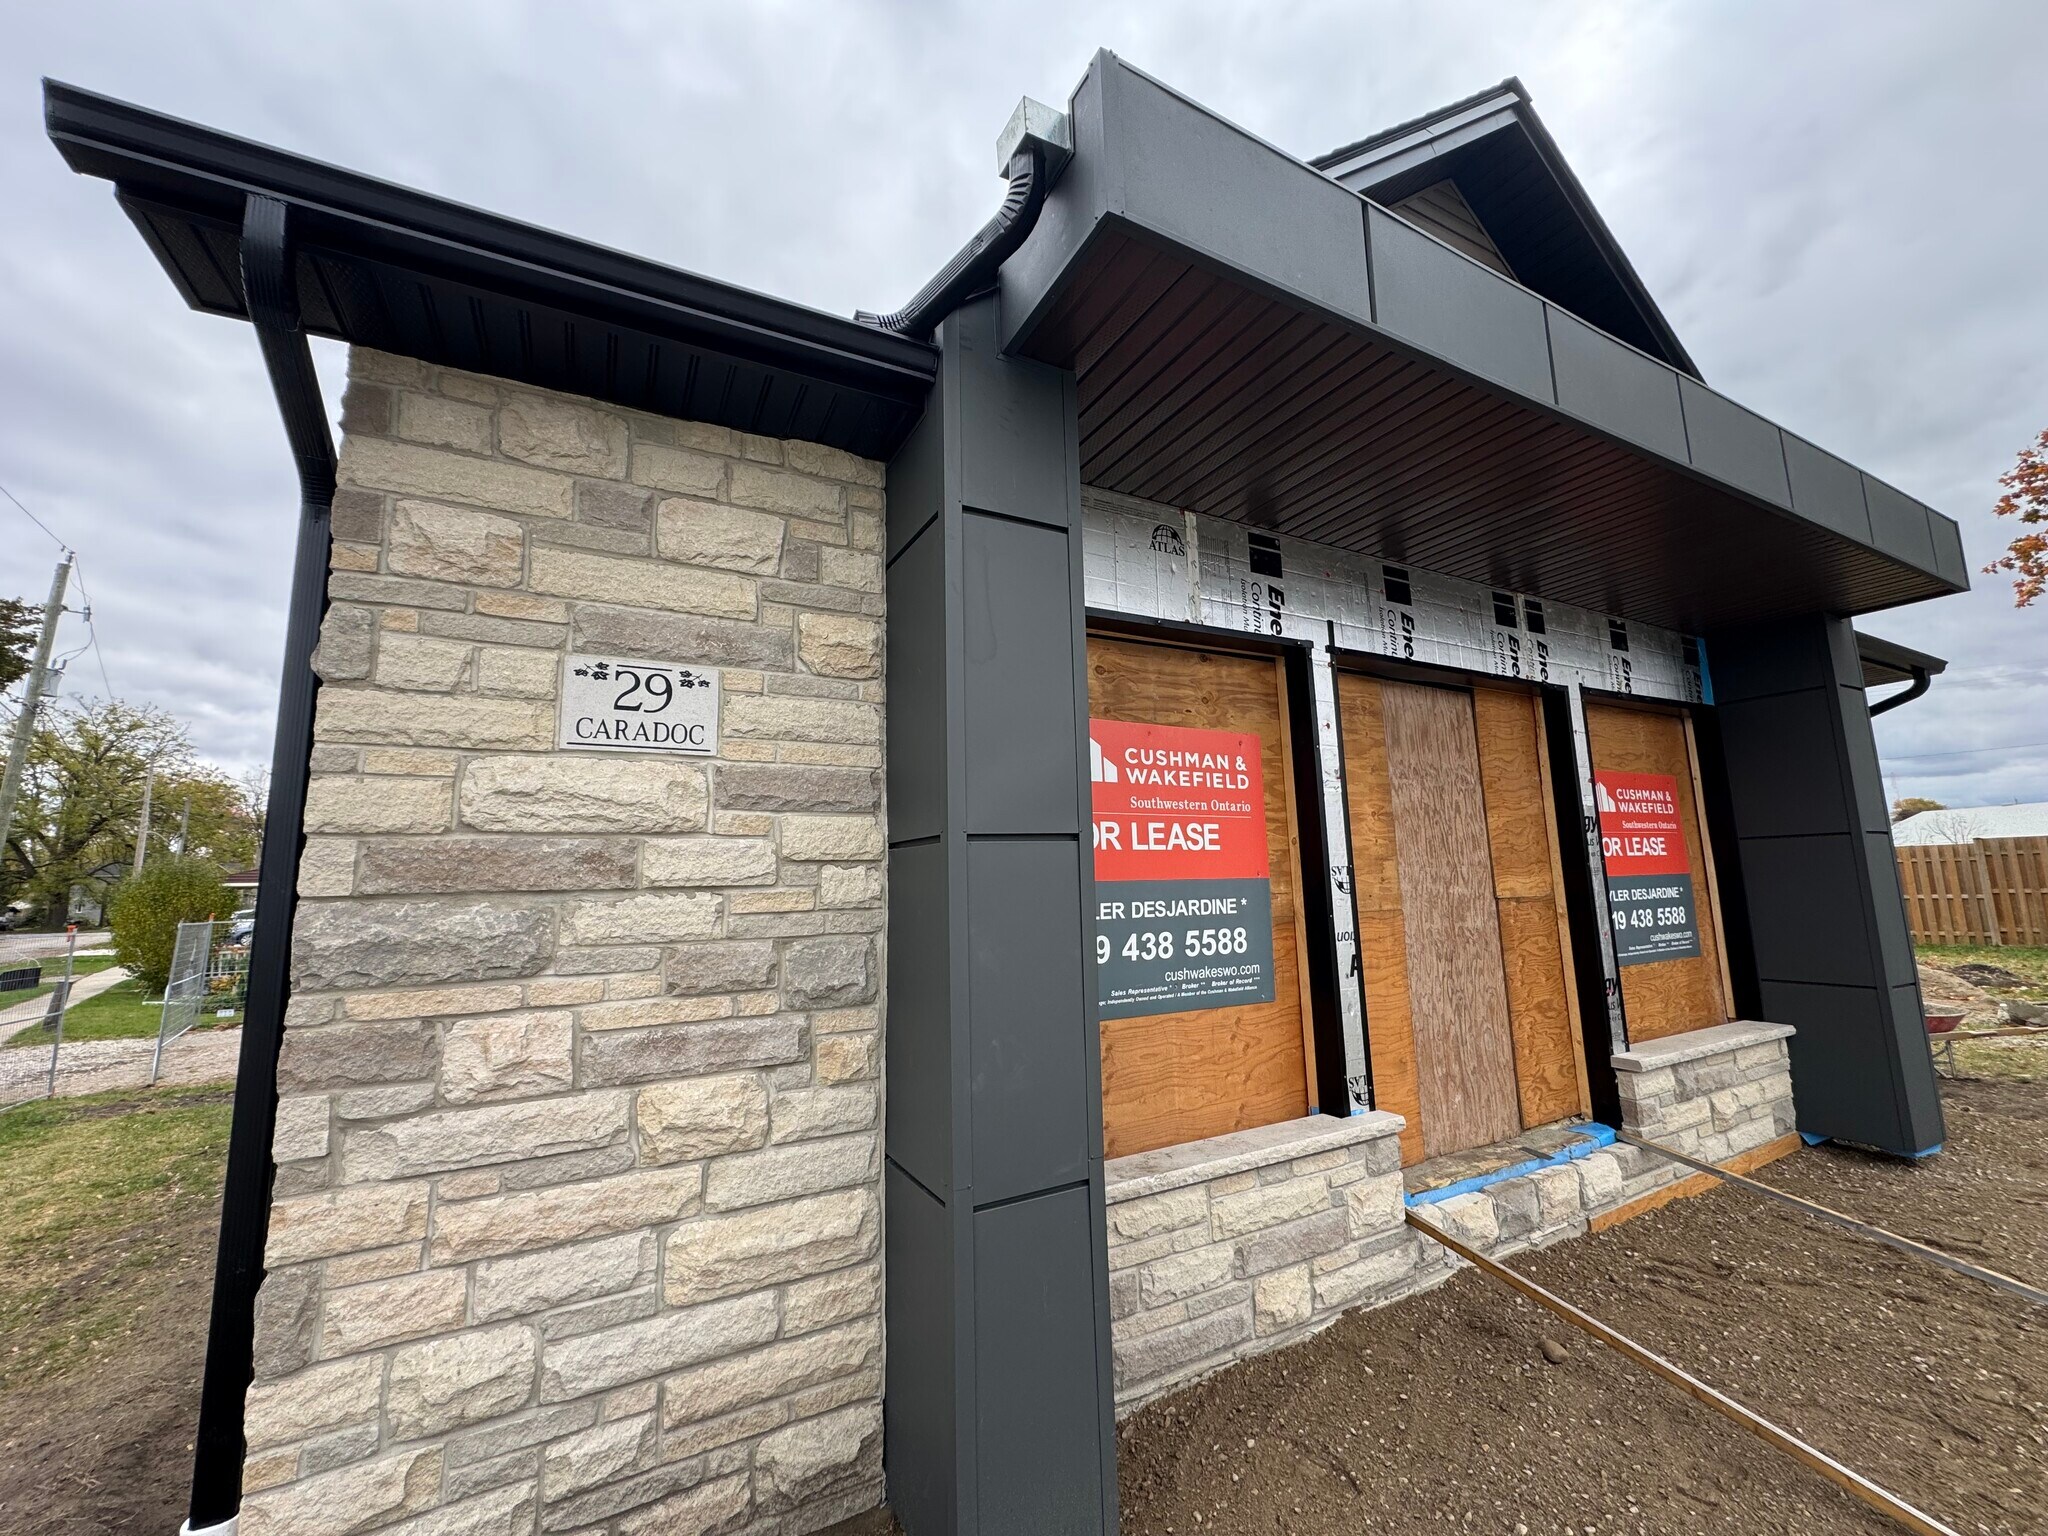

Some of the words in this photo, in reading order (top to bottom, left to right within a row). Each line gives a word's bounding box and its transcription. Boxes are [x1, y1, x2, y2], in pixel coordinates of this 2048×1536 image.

[1149, 540, 1185, 557] ATLAS
[613, 669, 673, 713] 29
[575, 717, 705, 745] CARADOC
[1125, 748, 1230, 770] CUSHMAN
[1235, 755, 1248, 771] &
[1125, 767, 1250, 790] WAKEFIELD
[1130, 796, 1208, 811] Southwestern
[1210, 800, 1251, 812] Ontario
[1616, 788, 1664, 801] CUSHMAN
[1665, 791, 1672, 802] &
[1618, 801, 1674, 815] WAKEFIELD
[1622, 820, 1658, 829] Southwestern
[1131, 821, 1221, 851] LEASE
[1624, 837, 1668, 857] LEASE
[1631, 887, 1680, 900] DESJARDINE
[1095, 902, 1126, 920] ER
[1131, 898, 1238, 919] DESJARDINE
[1630, 908, 1653, 928] 438
[1657, 905, 1686, 926] 5588
[1121, 931, 1174, 961] 438
[1184, 927, 1248, 957] 5588
[1164, 963, 1260, 982] cushwakeswo.com
[1127, 986, 1168, 995] Representative
[1235, 977, 1253, 985] Record
